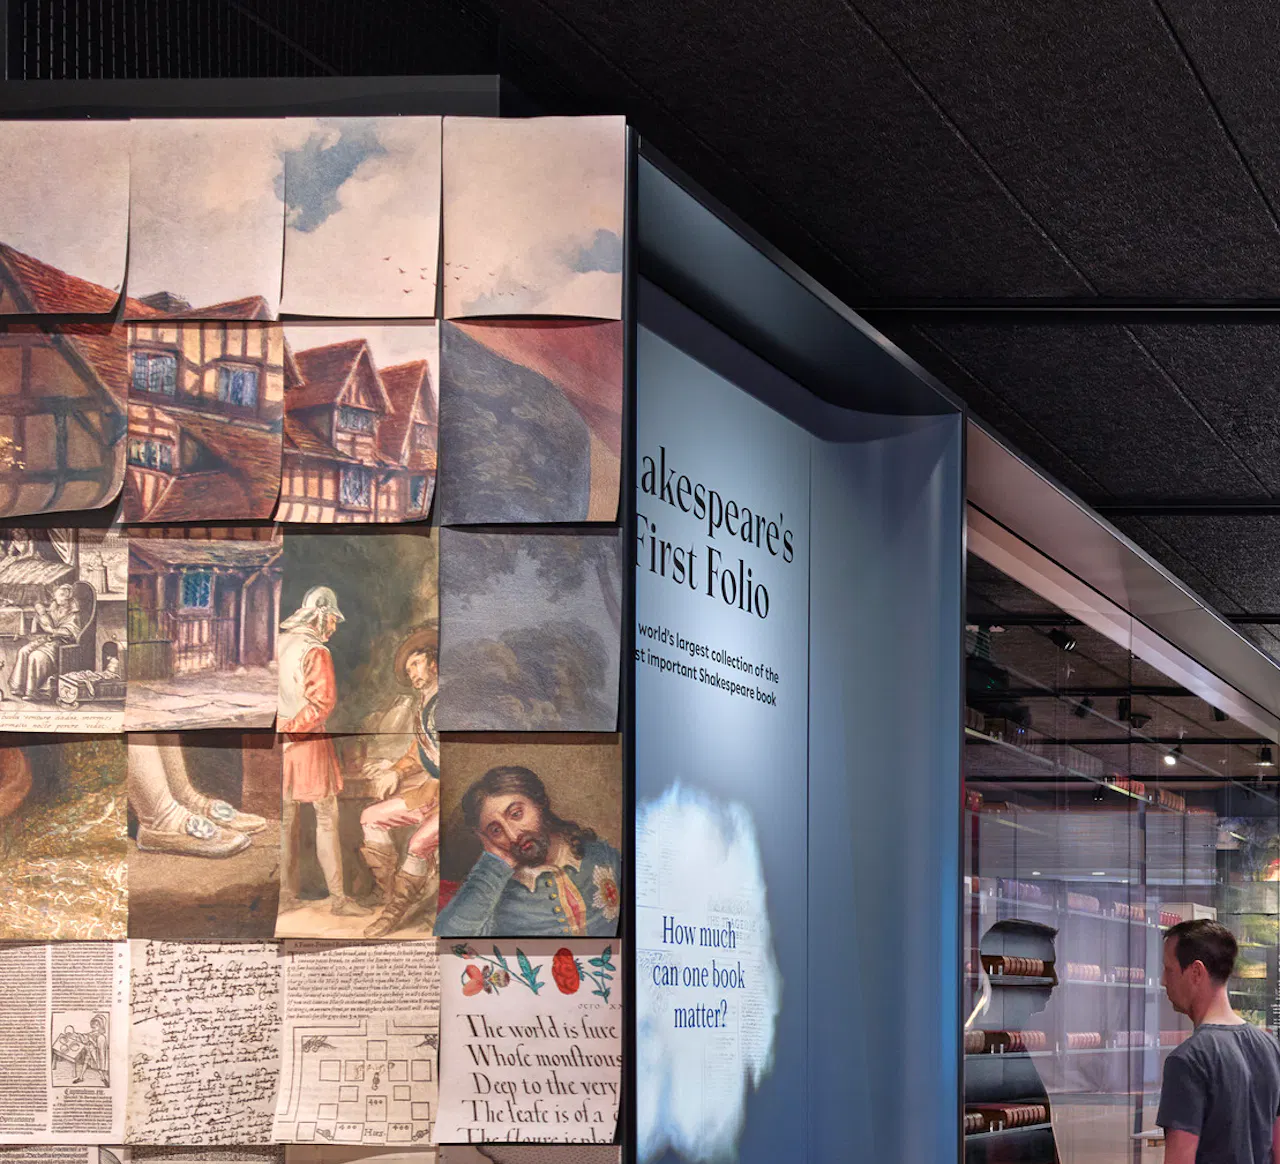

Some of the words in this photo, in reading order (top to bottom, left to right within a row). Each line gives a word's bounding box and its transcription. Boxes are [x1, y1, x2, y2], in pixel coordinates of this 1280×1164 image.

[640, 445, 794, 564] akespeare's
[636, 513, 698, 590] First
[706, 545, 769, 619] Folio
[638, 622, 675, 646] world's
[676, 632, 710, 660] largest
[711, 649, 753, 675] collection
[754, 664, 764, 678] of
[765, 667, 779, 684] the
[635, 648, 645, 663] st
[647, 648, 697, 680] important
[699, 668, 755, 699] Shakespeare
[756, 687, 777, 706] book
[662, 916, 696, 945] How
[700, 921, 736, 949] much
[653, 965, 679, 986] can
[683, 966, 709, 987] one
[712, 959, 745, 989] book
[456, 1014, 507, 1038] The
[508, 1015, 560, 1038] world
[563, 1022, 579, 1038] is
[674, 998, 728, 1028] matter?
[468, 1072, 517, 1105] Deep
[522, 1078, 542, 1094] to
[545, 1070, 578, 1095] the
[580, 1081, 618, 1106] very
[461, 1099, 504, 1123] The
[554, 1104, 569, 1123] is
[574, 1098, 591, 1123] of
[593, 1110, 604, 1123] a
